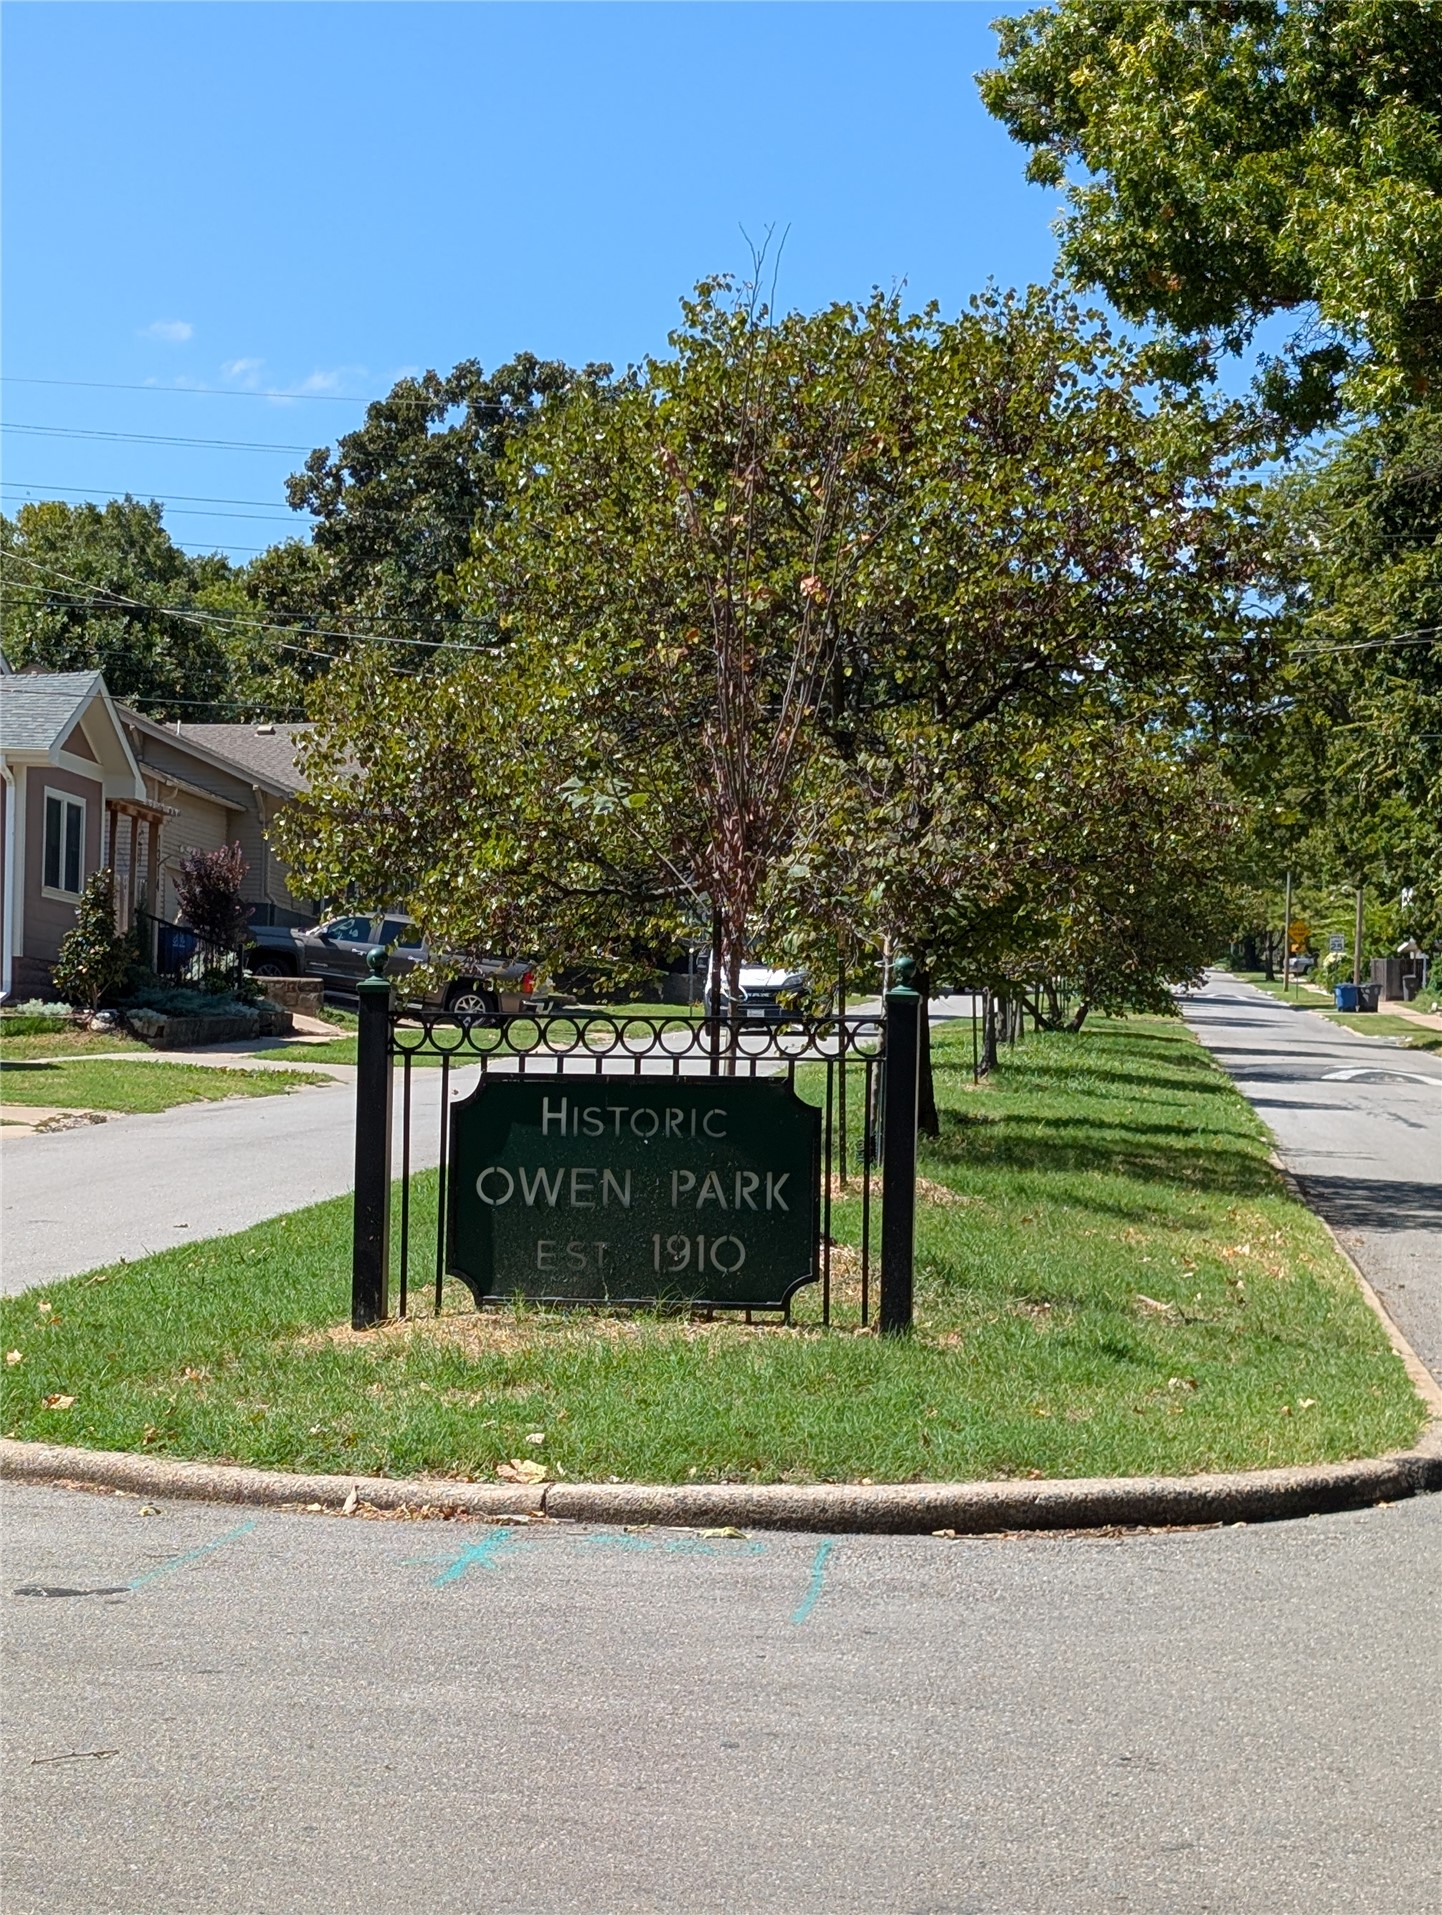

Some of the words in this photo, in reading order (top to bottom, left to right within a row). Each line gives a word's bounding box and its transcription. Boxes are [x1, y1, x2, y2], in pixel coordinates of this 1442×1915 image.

[1330, 943, 1343, 951] 25
[542, 1096, 728, 1138] HISTORIC
[476, 1166, 632, 1209] OWEN
[671, 1169, 790, 1211] PARK
[537, 1240, 610, 1271] EST
[652, 1233, 746, 1273] 1910
